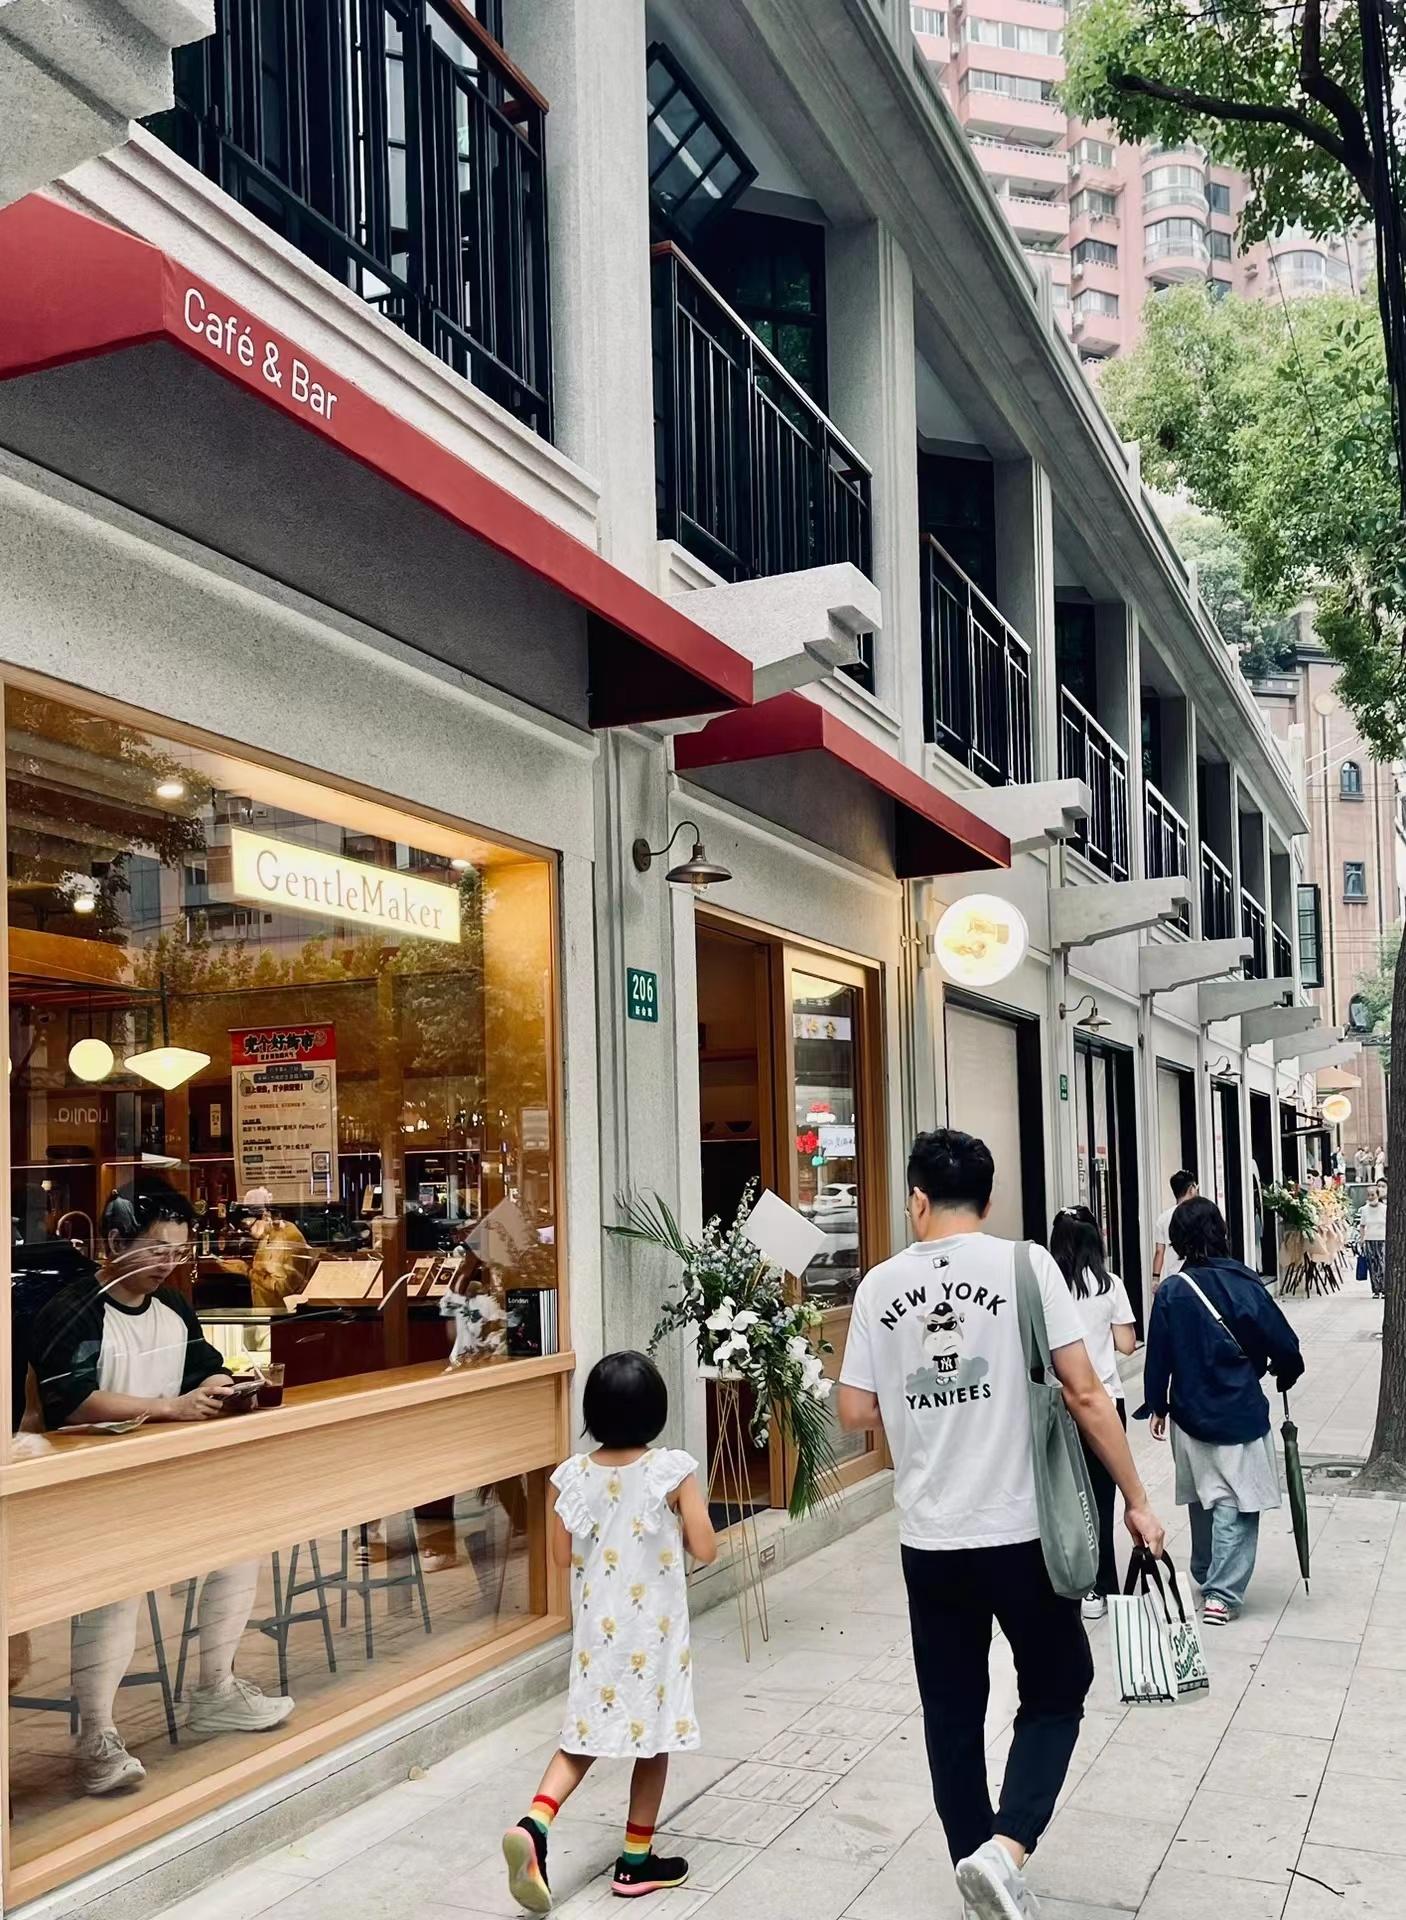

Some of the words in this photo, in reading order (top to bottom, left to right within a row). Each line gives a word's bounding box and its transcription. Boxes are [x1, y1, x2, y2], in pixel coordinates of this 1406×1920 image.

[184, 288, 254, 367] Café
[262, 341, 282, 388] &
[291, 358, 338, 419] Bar
[256, 849, 443, 929] GentleMaker
[632, 974, 654, 1003] 206
[880, 1286, 927, 1331] NEW
[941, 1282, 1007, 1316] YORK
